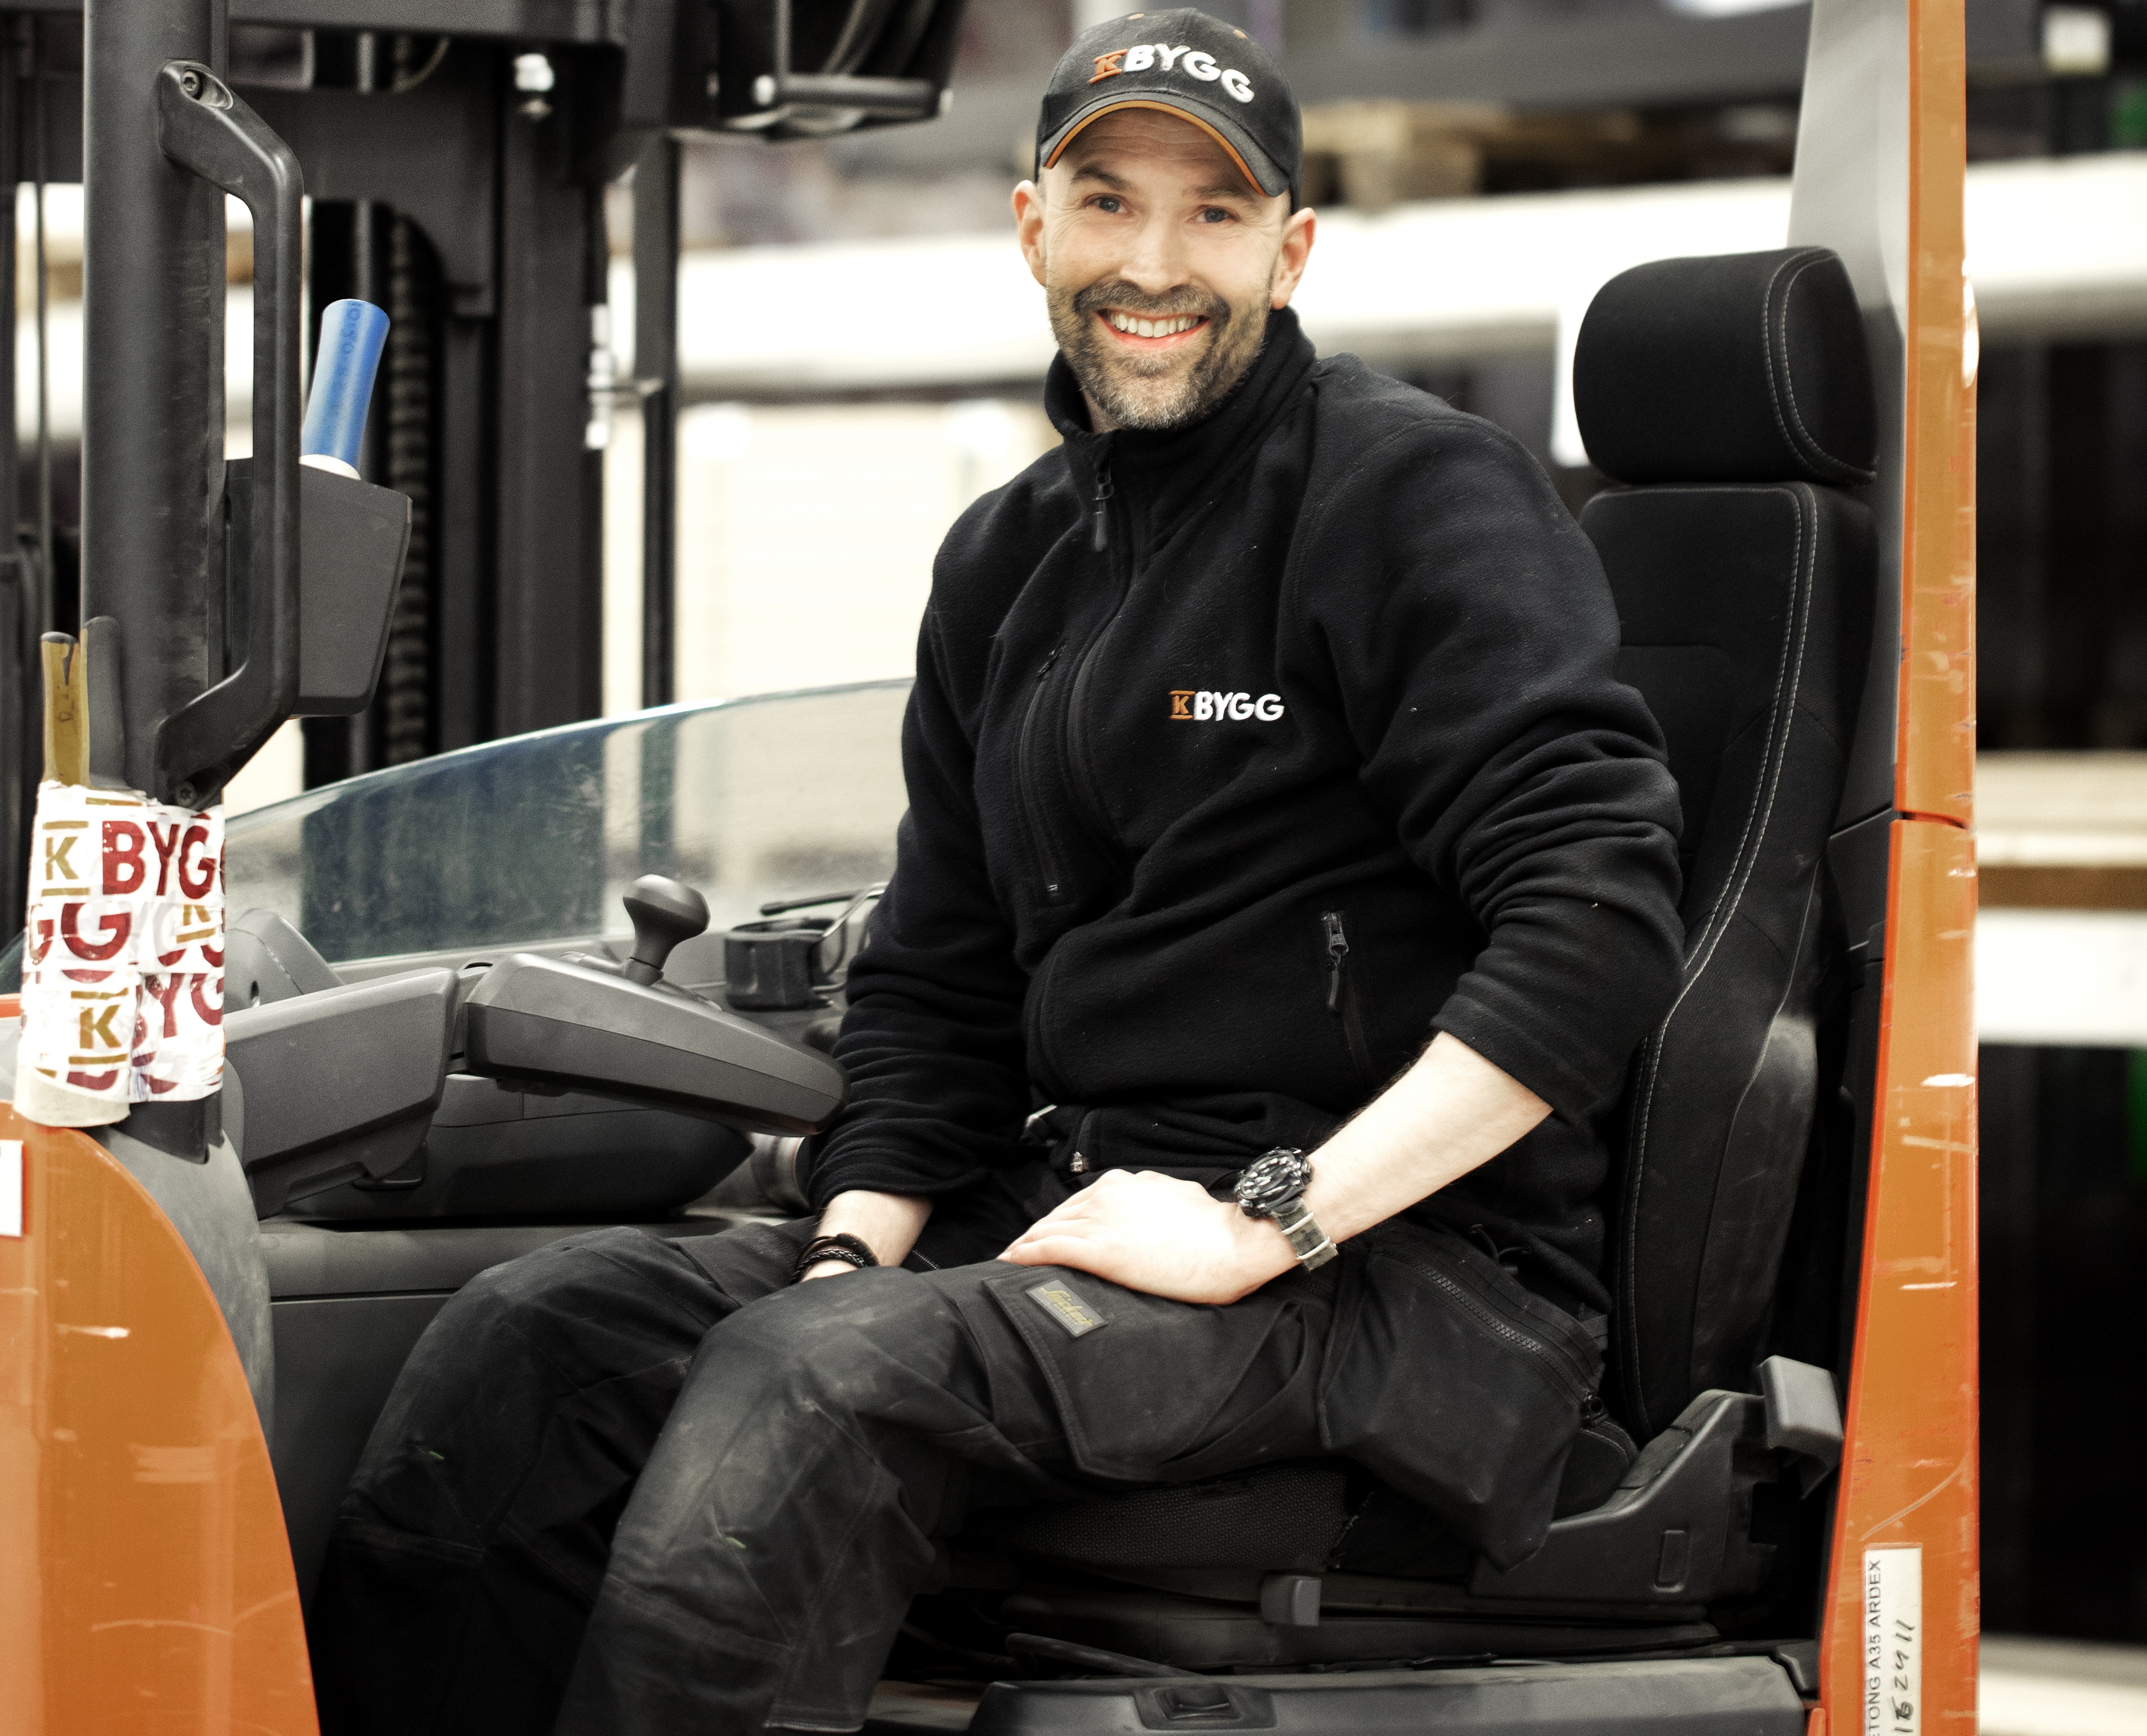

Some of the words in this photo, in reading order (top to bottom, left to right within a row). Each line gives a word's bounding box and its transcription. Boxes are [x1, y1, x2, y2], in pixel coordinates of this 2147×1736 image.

[102, 821, 225, 900] BYG
[1869, 1559, 1882, 1628] ARDEX
[1869, 1633, 1882, 1669] A35
